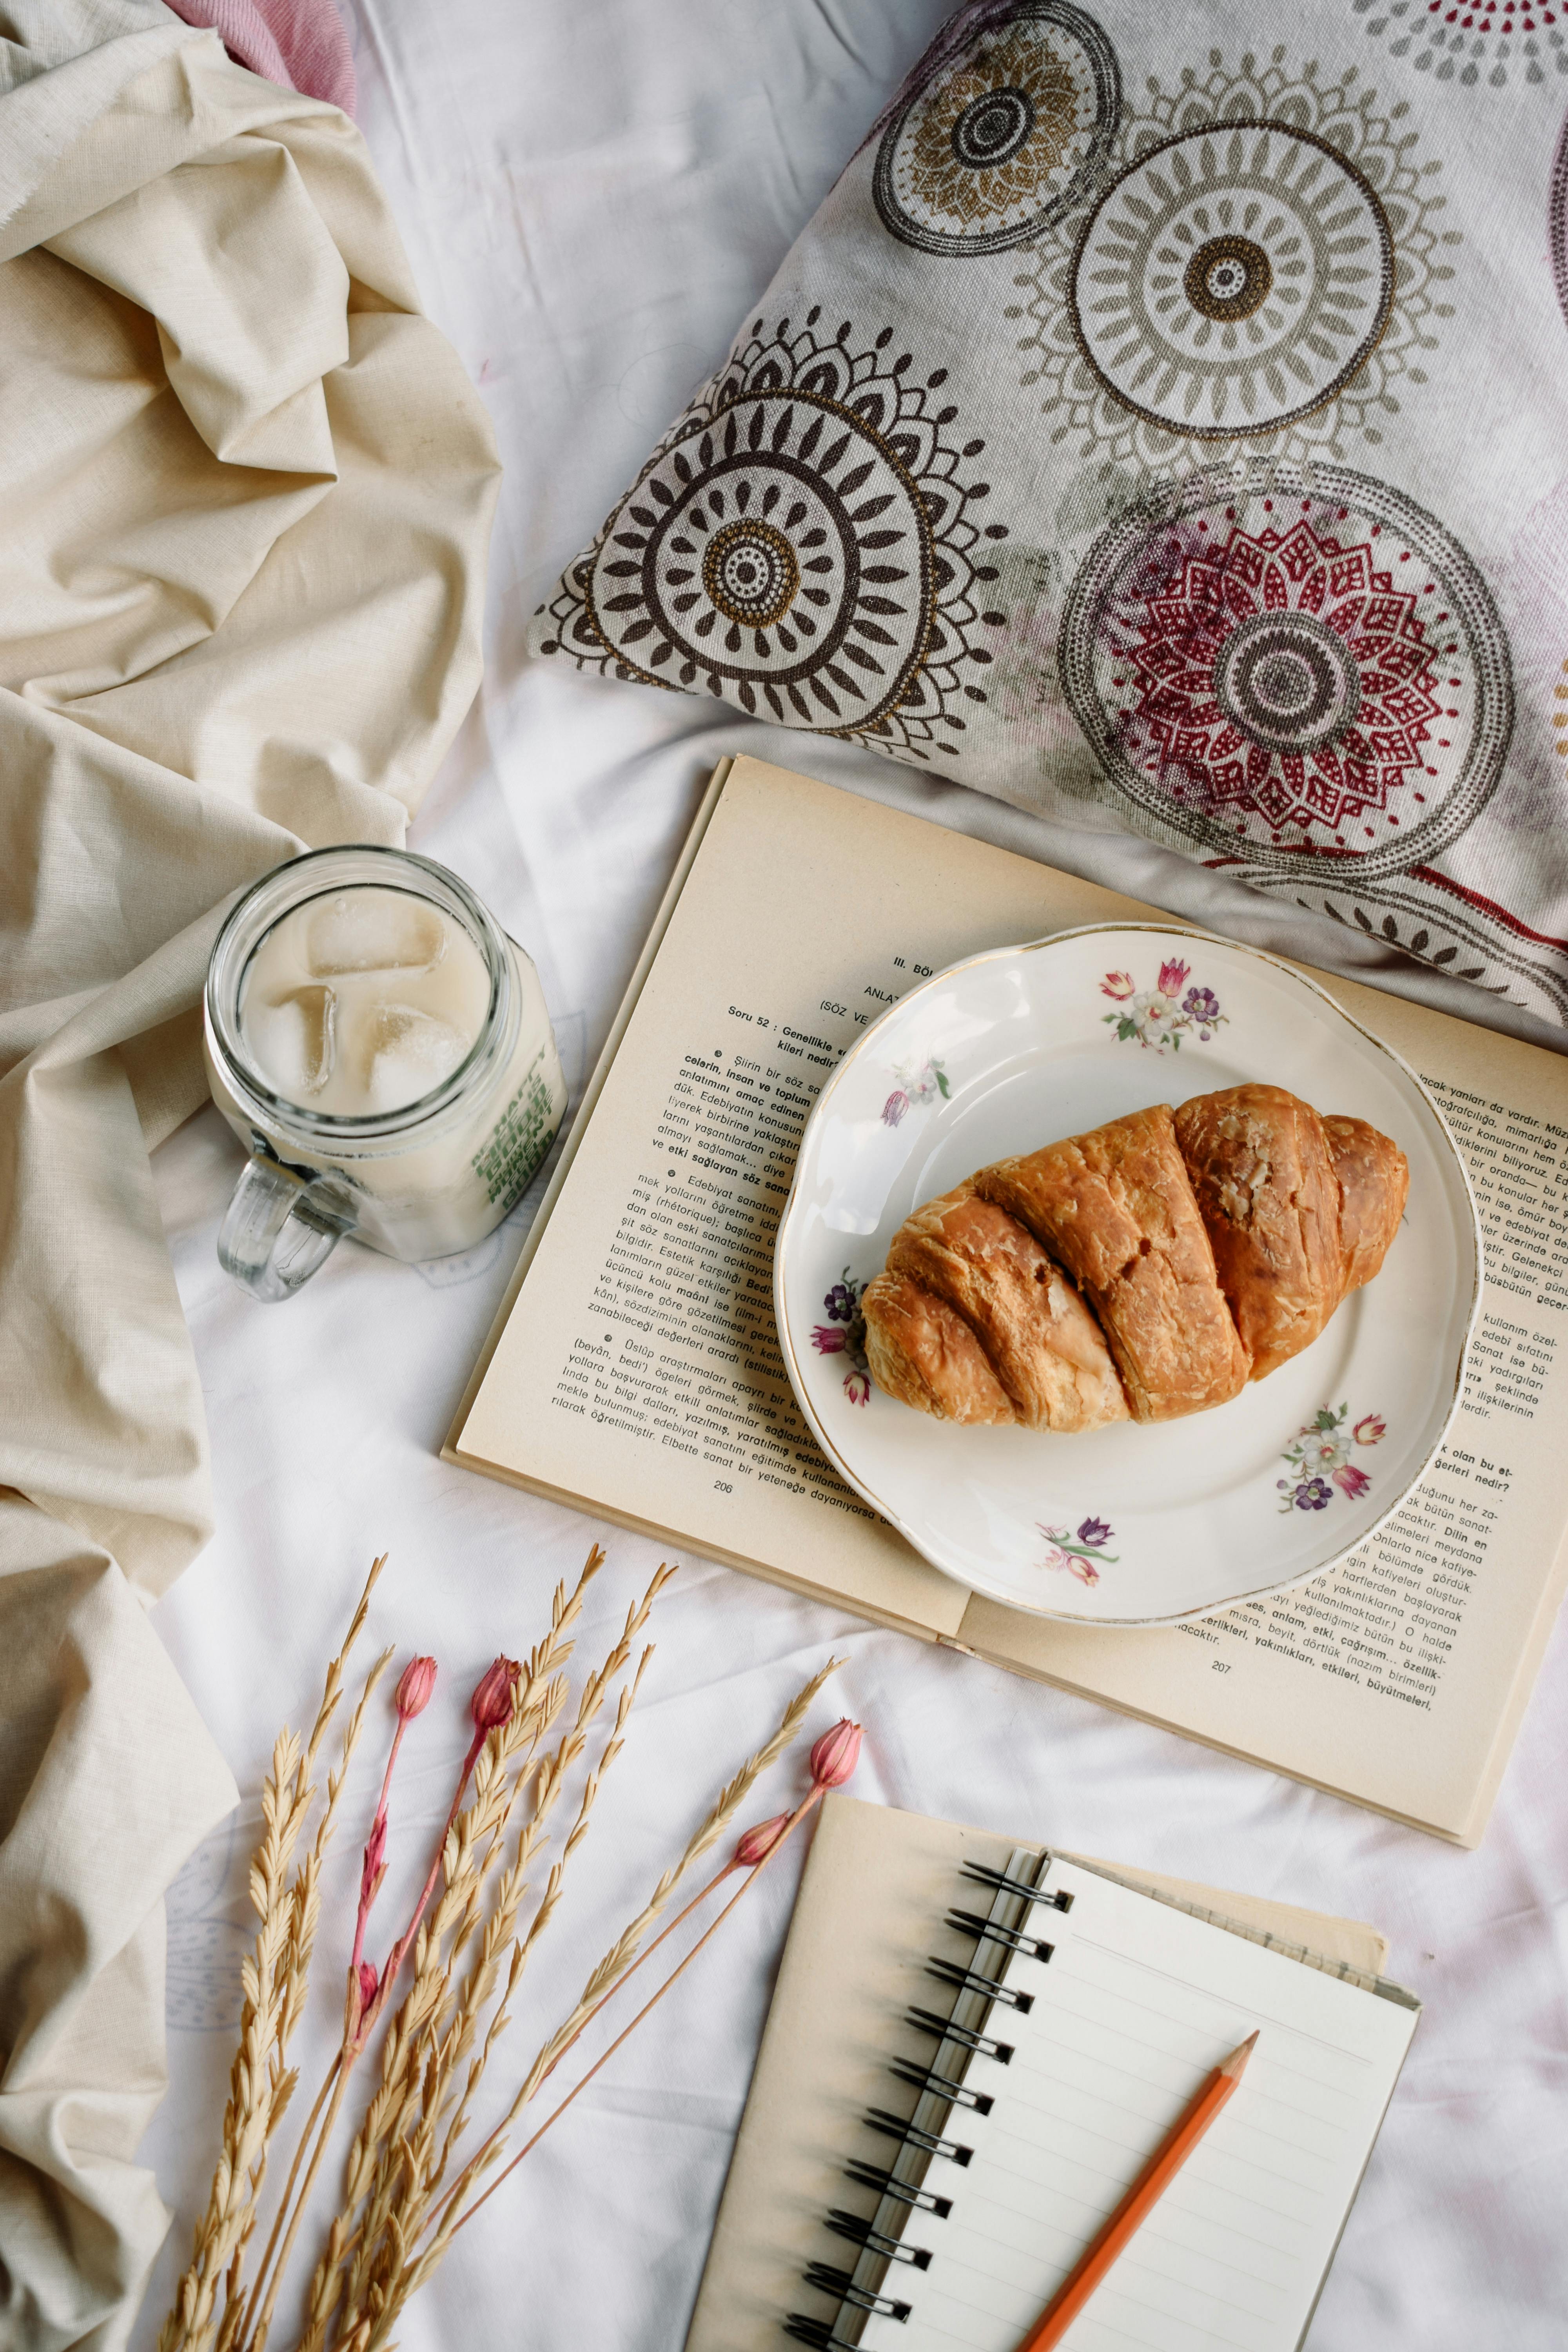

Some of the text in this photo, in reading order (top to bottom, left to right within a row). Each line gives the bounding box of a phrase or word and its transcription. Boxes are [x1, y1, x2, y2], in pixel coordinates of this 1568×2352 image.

[893, 956, 906, 969] III.
[728, 1005, 832, 1052] Soru 52 Genellikle
[820, 1000, 869, 1025] (SÖZ VE
[777, 1039, 804, 1057] kileri
[734, 1055, 804, 1089] Şiirin bir söz
[493, 1043, 545, 1136] HAPPY
[700, 1091, 753, 1118] Edebiyatın
[735, 1090, 764, 1106] amaç
[759, 1082, 811, 1107] ve toplum
[706, 1109, 749, 1132] birbirine
[1449, 1087, 1539, 1129] yanları da vardır.
[475, 1073, 541, 1177] LIFE IS
[485, 1081, 546, 1182] GOOD
[662, 1109, 764, 1154] larını yaşantılardan
[1505, 1125, 1557, 1150] mimarlığa
[488, 1089, 552, 1195] ENJOY THE
[490, 1099, 552, 1204] MOMENT
[657, 1125, 785, 1178] almayı diye
[1533, 1149, 1555, 1165] hem
[502, 1128, 554, 1210] GOOD
[508, 1138, 543, 1187] FEEL
[652, 1138, 761, 1185] ve etki sağlayan söz
[1470, 1156, 1557, 1197] bir bu
[1502, 1153, 1548, 1178] biliyoruz.
[664, 1184, 706, 1205] yollarını
[711, 1200, 754, 1223] öğretme
[687, 1175, 733, 1200] Edebiyat
[1497, 1183, 1559, 1213] konular her
[626, 1202, 699, 1235] dan olan eski
[632, 1189, 651, 1202] miş
[724, 1221, 762, 1243] başlıca
[1489, 1212, 1550, 1242] ve edebiyat
[1517, 1206, 1545, 1223] ömür
[621, 1217, 718, 1258] şit söz sanatlarını
[1502, 1231, 1546, 1256] üzerinde
[610, 1243, 731, 1295] lanımların güzel etkiler
[615, 1229, 741, 1284] bilgidir. Estetik karşılığı
[1512, 1251, 1563, 1278] Gelenekçi
[605, 1258, 730, 1312] üçüncü kolu ise
[600, 1274, 612, 1284] ve
[616, 1278, 653, 1299] kişilere
[686, 1307, 746, 1334] gözetilmesi
[624, 1299, 687, 1328] sözdiziminin
[587, 1302, 739, 1363] zanabileceği değerleri arardı
[1483, 1312, 1557, 1347] kullanım özel-
[1472, 1340, 1525, 1367] Sanat ise
[1516, 1343, 1553, 1362] sıfatını
[568, 1354, 760, 1428] yollara başvurarak anlatımlar
[659, 1355, 786, 1405] araştırmaları apayrı bir
[1489, 1365, 1543, 1390] yadırgıları
[1494, 1383, 1539, 1405] şeklinde
[562, 1366, 589, 1383] lında
[594, 1377, 608, 1390] bu
[614, 1385, 638, 1401] bilgi
[642, 1396, 678, 1417] dalları,
[737, 1431, 789, 1457] yaratılmış
[655, 1367, 692, 1388] ögeleri
[784, 1415, 797, 1426] ve
[1477, 1390, 1534, 1418] ilişkilerinin
[557, 1382, 797, 1474] mekle bulunmuş; edebiyat sanatını eğitimde
[551, 1397, 876, 1520] rılarak öğretilmiştir. Elbette sanat bir dayanıyorsa
[1452, 1450, 1494, 1471] olan bu
[713, 1480, 733, 1494] 206
[1474, 1474, 1510, 1492] nedir?
[1424, 1501, 1492, 1534] bütün sanat-
[1459, 1499, 1498, 1519] her za-
[1434, 1540, 1483, 1564] meydana
[1444, 1526, 1487, 1550] Dilin en
[1378, 1550, 1423, 1574] bölümde
[1415, 1549, 1477, 1577] nice kafiye-
[1342, 1569, 1462, 1622] harflerden başlayarak
[1372, 1564, 1466, 1605] kafiyeleri oluştur-
[1272, 1610, 1334, 1641] anlam, etki,
[1333, 1584, 1457, 1637] yakınlıklarına dayanan
[1229, 1609, 1382, 1674] mısra, beyit, dörtlük (nazım
[1364, 1626, 1446, 1664] bütün bu ilişki-
[1405, 1626, 1452, 1651] O halde
[1211, 1660, 1231, 1673] 207
[1254, 1636, 1315, 1666] yakınlıkları,
[1321, 1662, 1359, 1684] etkileri,
